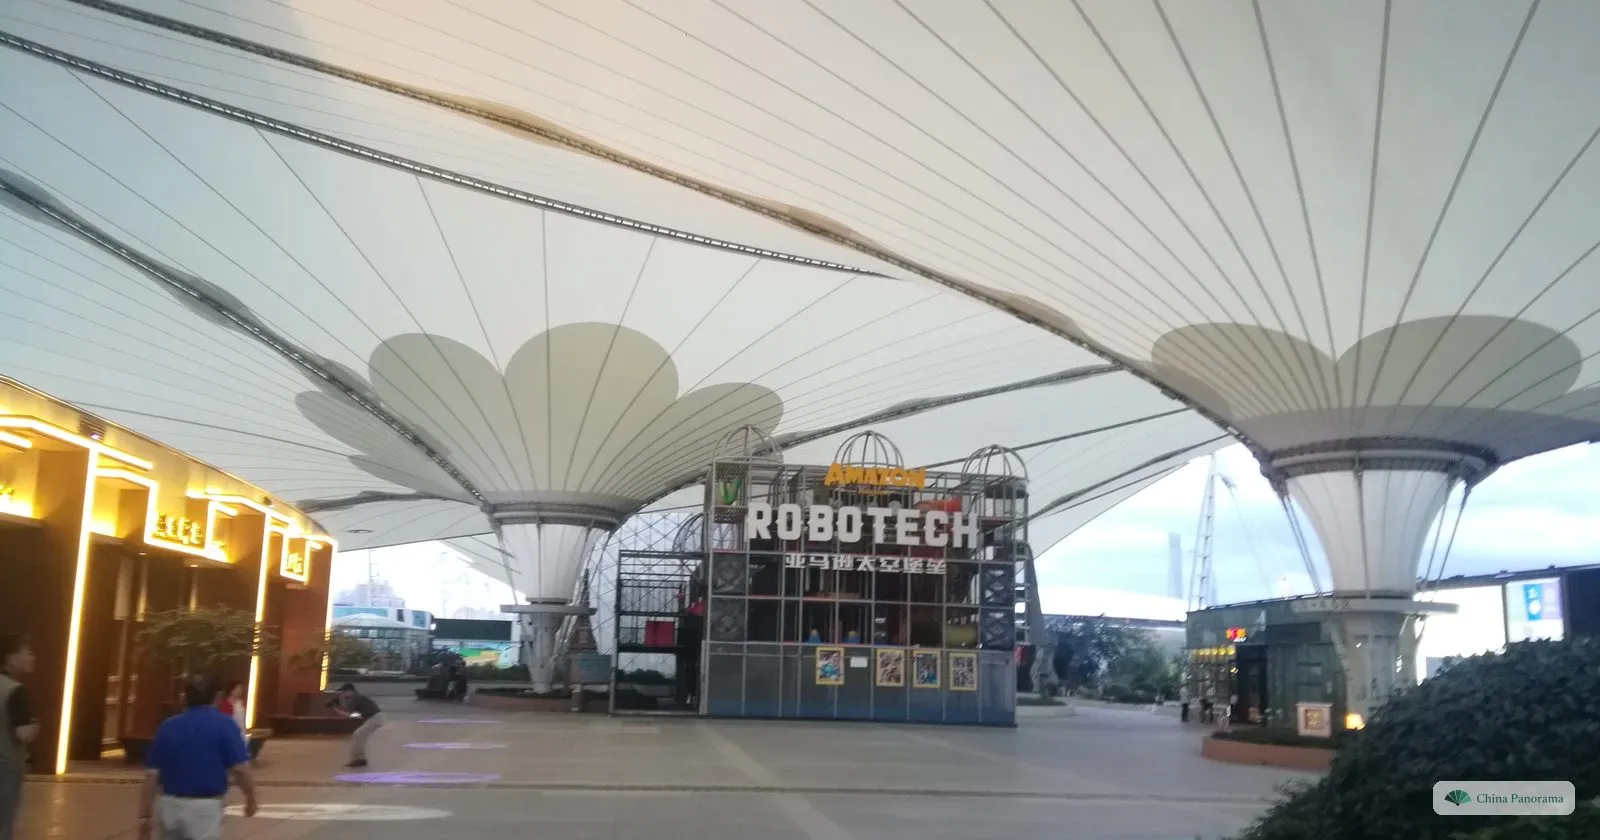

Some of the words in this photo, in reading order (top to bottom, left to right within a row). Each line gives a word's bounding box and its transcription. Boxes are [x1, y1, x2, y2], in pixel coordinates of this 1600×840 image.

[824, 462, 926, 489] AMAZON
[747, 502, 979, 549] ROBOTECH
[784, 552, 948, 575] 亚马逊太空堡垒
